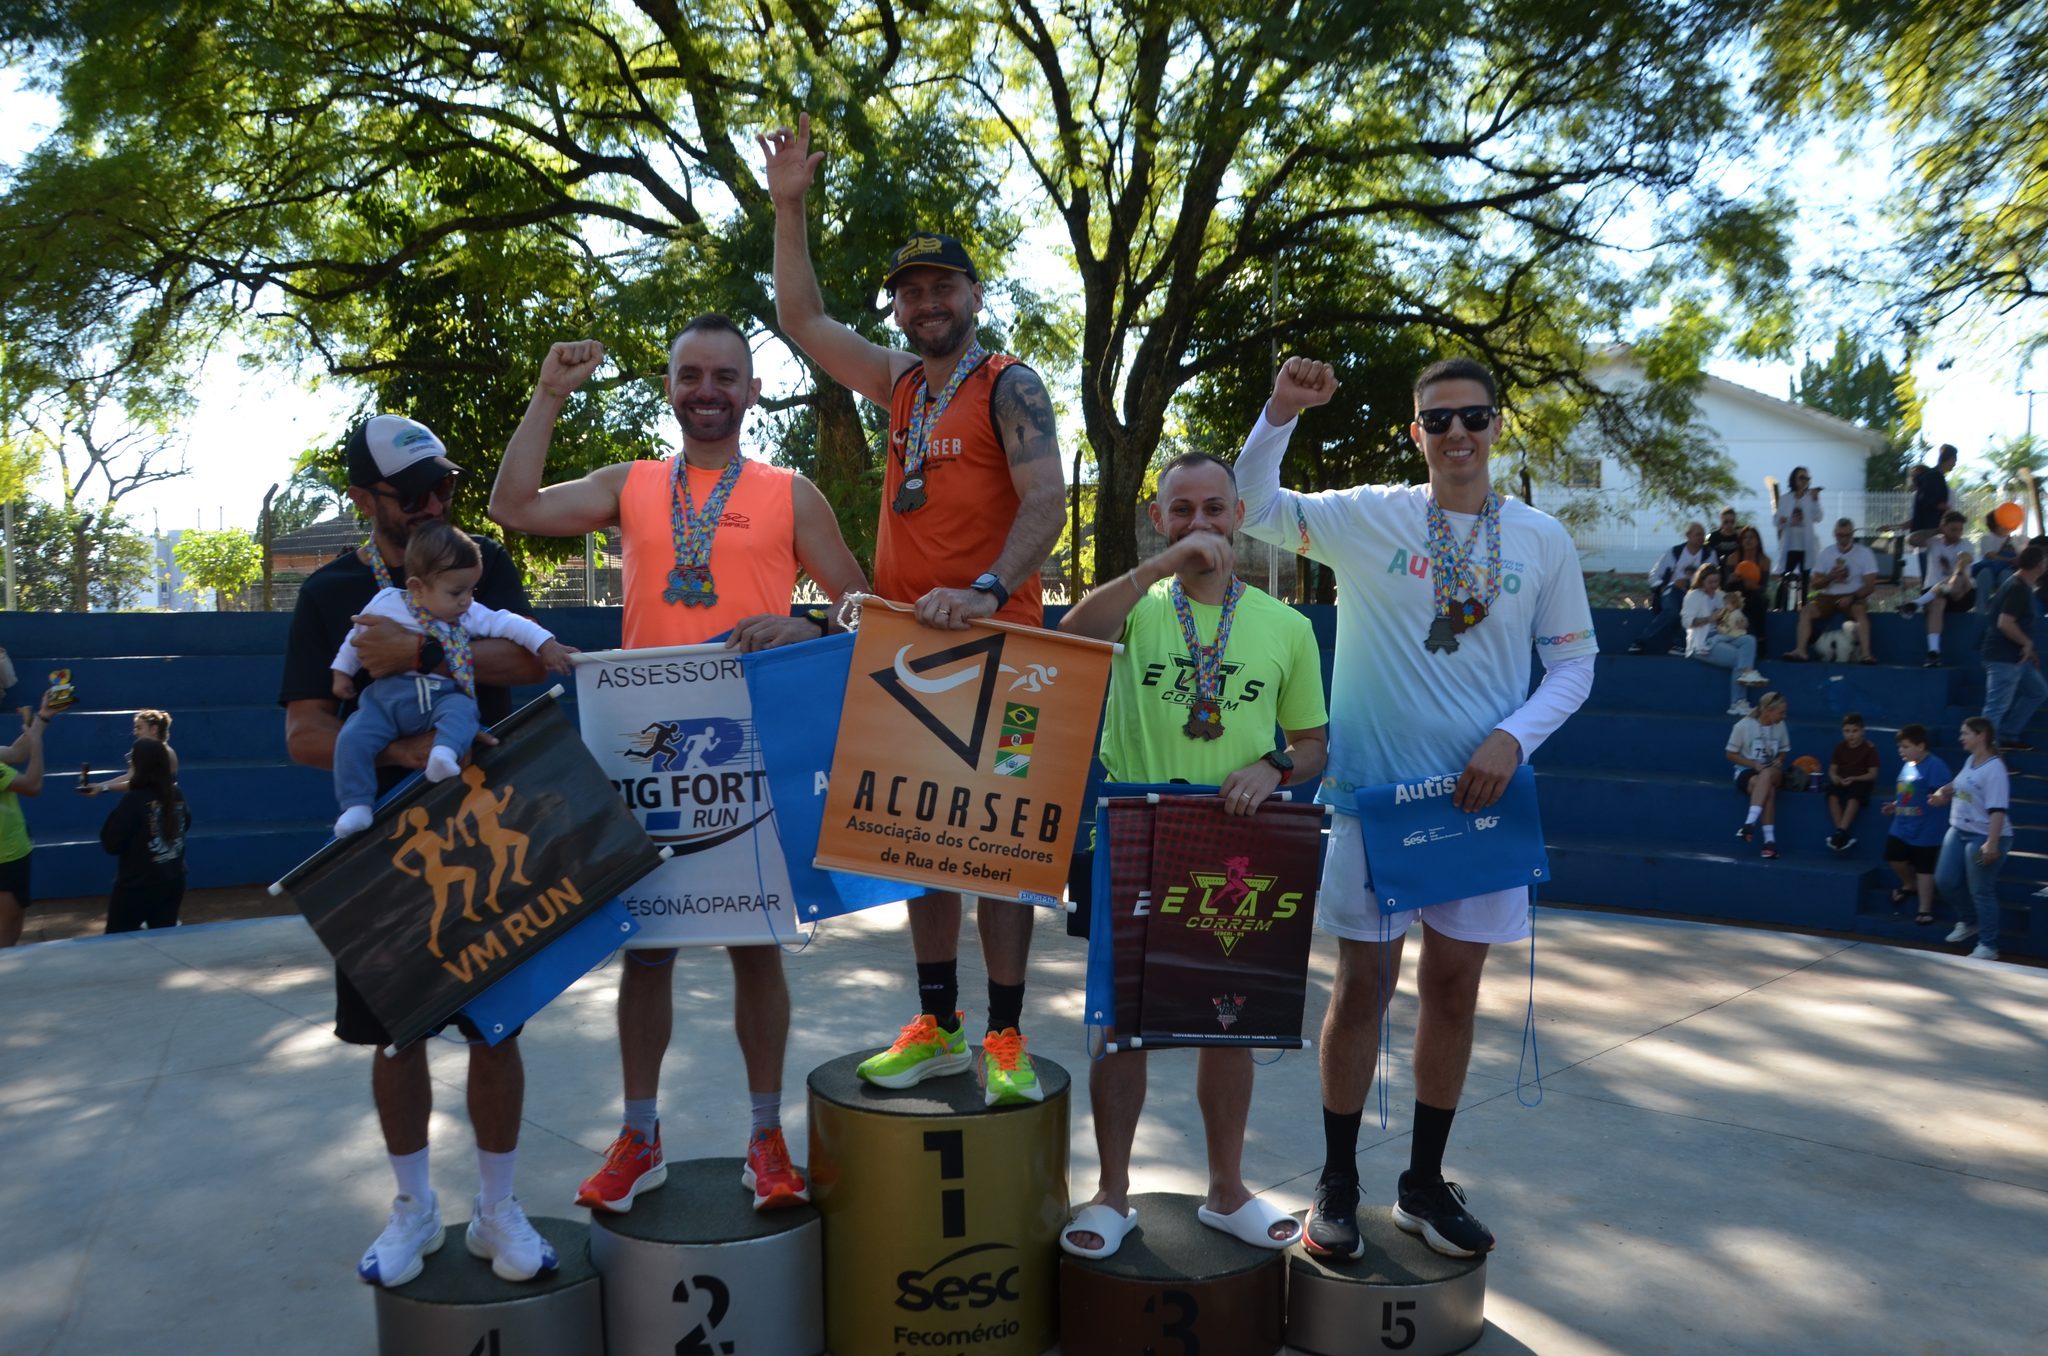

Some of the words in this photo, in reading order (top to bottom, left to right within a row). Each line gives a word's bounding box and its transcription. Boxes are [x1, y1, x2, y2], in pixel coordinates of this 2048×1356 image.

[671, 770, 767, 807] FORT
[853, 769, 1062, 843] ACORSEB
[1395, 776, 1463, 805] Autis
[693, 807, 739, 828] RUN
[846, 815, 931, 844] Associação
[936, 829, 963, 849] dos
[968, 836, 1054, 864] Corredores
[880, 847, 900, 864] de
[905, 851, 933, 870] Rua
[938, 857, 958, 873] de
[962, 861, 1012, 883] Seberi
[624, 894, 782, 917] ÉSÓNÃOPARAR
[1160, 886, 1304, 919] ELAS
[441, 930, 508, 984] VM
[502, 877, 583, 947] RUN
[1186, 916, 1274, 932] CORREM
[923, 1129, 966, 1239] 1
[672, 1275, 735, 1356] 2
[894, 1319, 1020, 1346] Fecomércio
[1143, 1290, 1199, 1356] 3
[1380, 1300, 1416, 1350] 5
